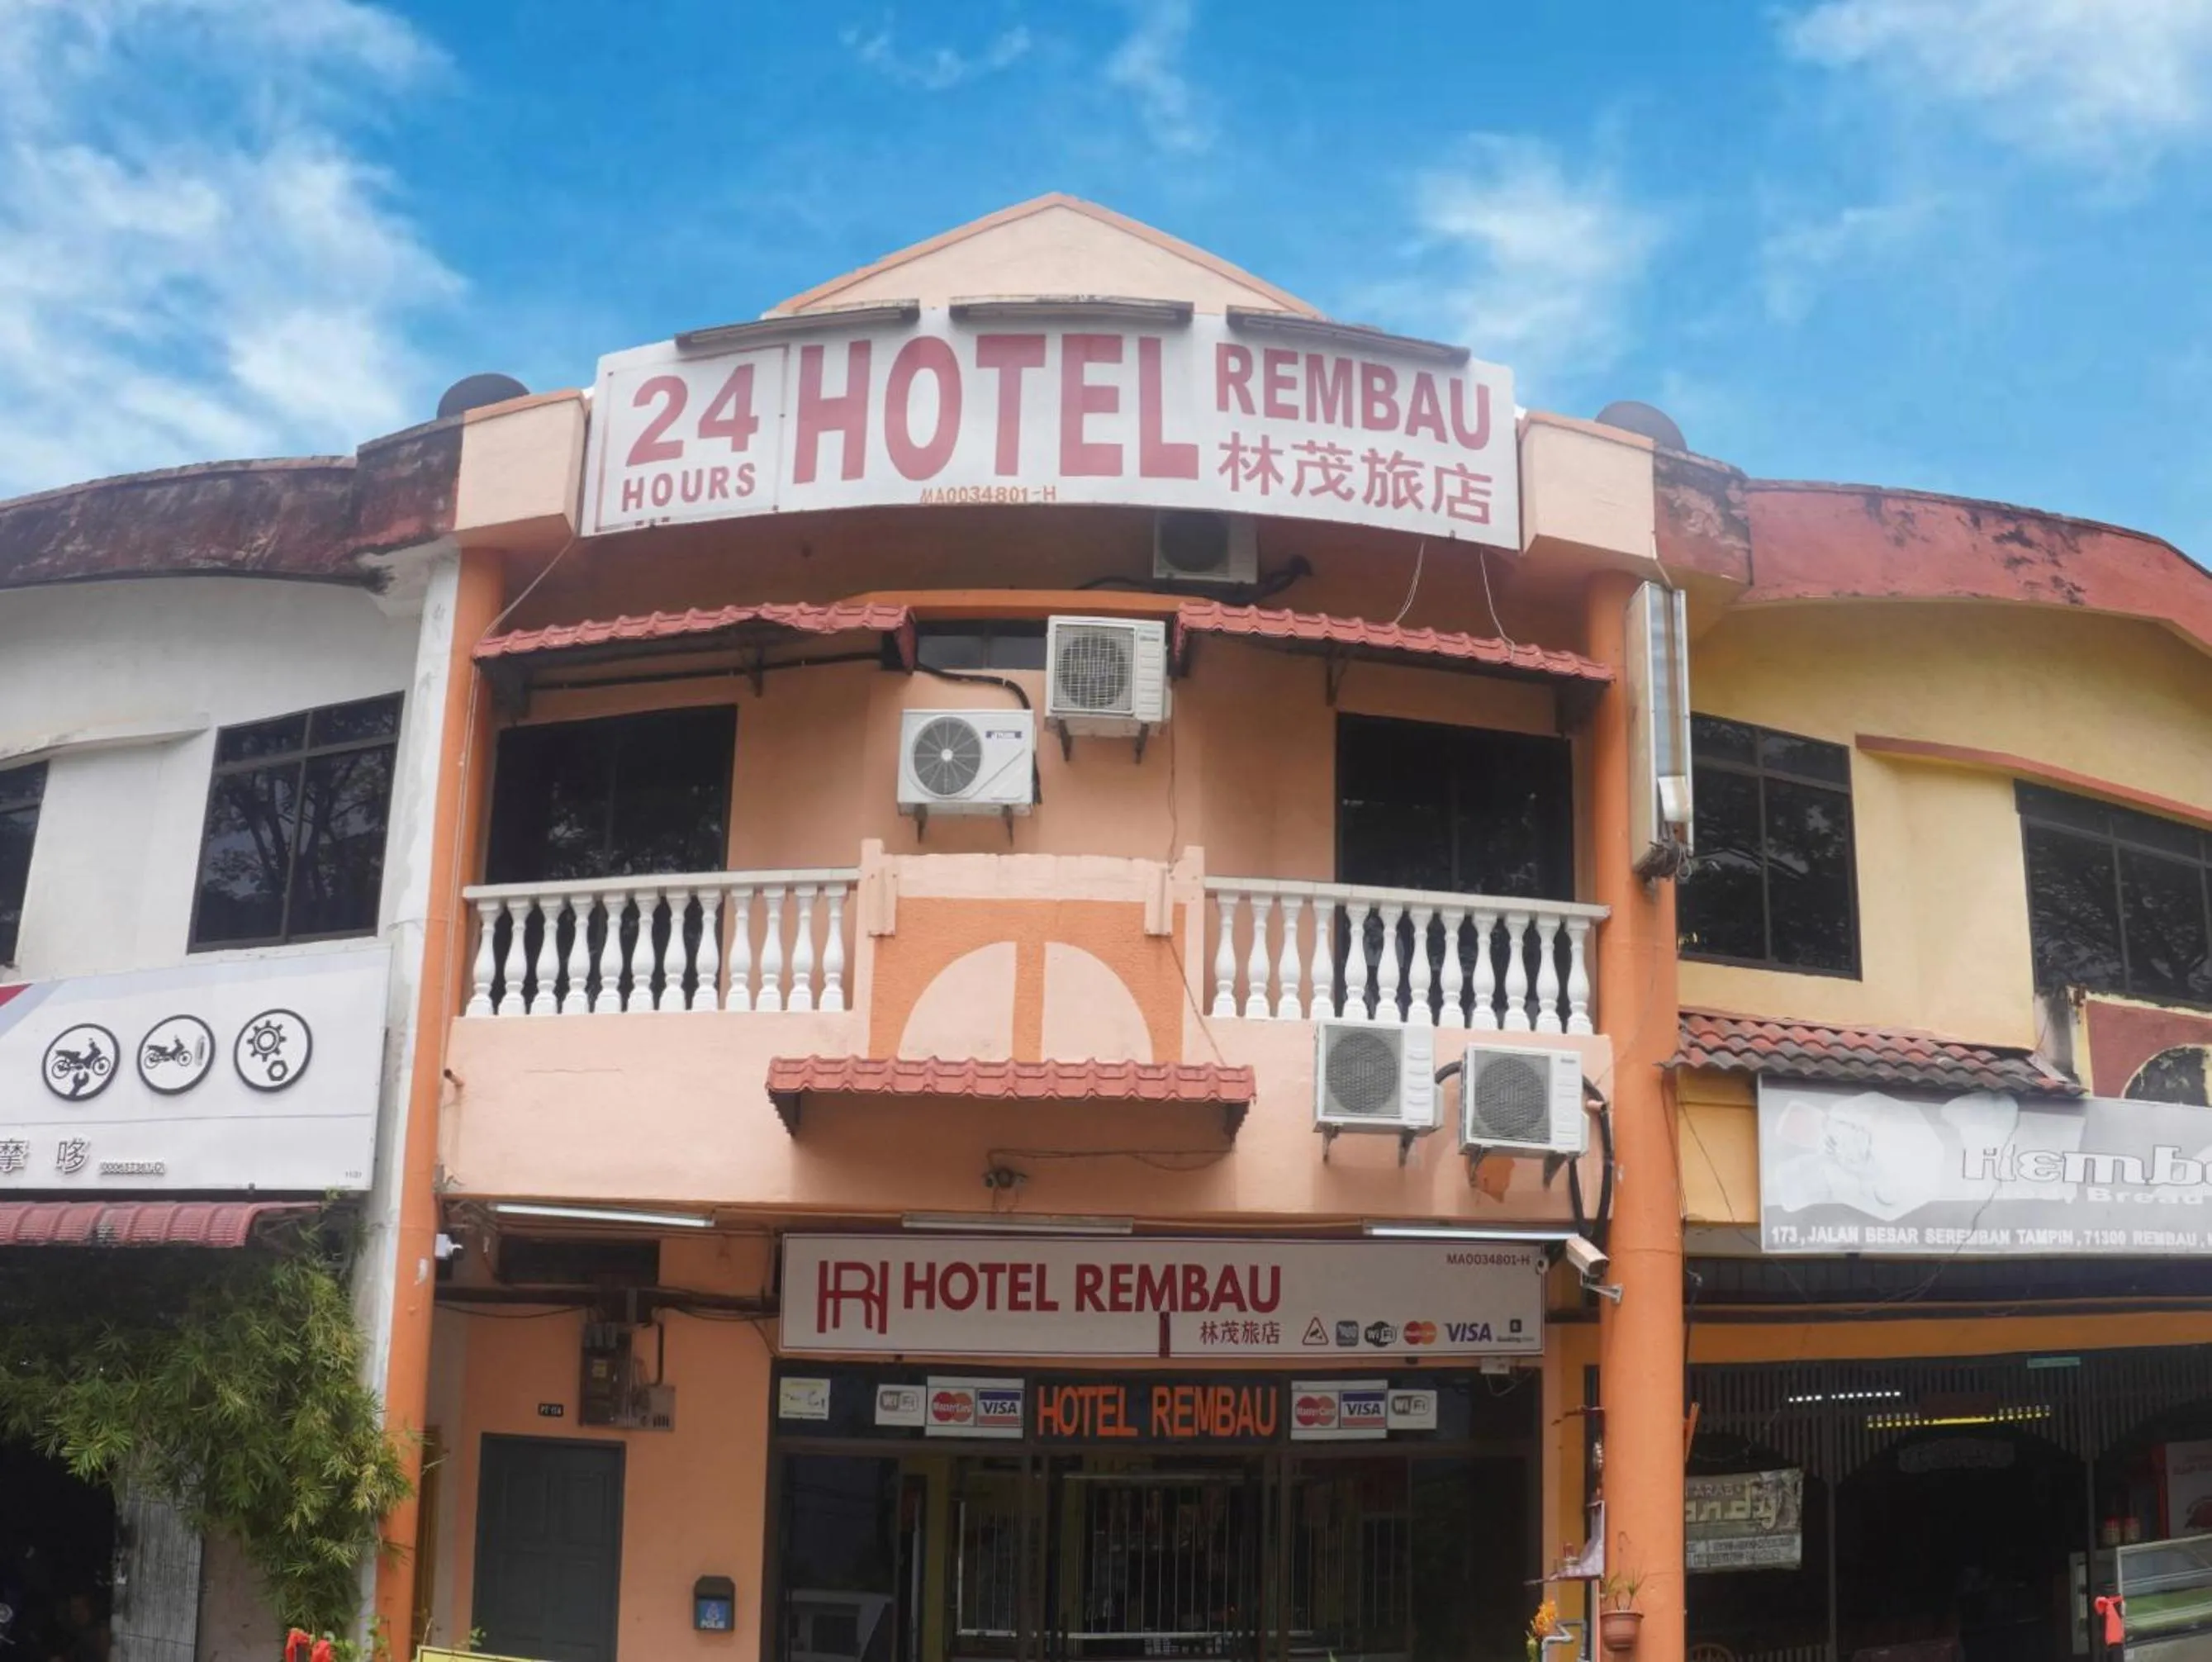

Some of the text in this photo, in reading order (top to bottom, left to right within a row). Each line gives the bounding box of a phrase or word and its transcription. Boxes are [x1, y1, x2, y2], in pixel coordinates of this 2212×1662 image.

[625, 362, 760, 468] 24
[793, 333, 1199, 484] HOTEL
[1216, 341, 1490, 451] REMBAU
[621, 462, 757, 513] HOURS
[919, 485, 1057, 504] MA0034801-H
[1218, 430, 1493, 525] 林茂旅店
[1806, 1226, 1859, 1244] JALAN
[1864, 1227, 1919, 1245] BESAR
[1925, 1228, 2011, 1245] SEREMBAN
[904, 1261, 1281, 1314] HOTEL REMBAU
[1199, 1321, 1281, 1346] 林茂旅店
[1445, 1323, 1492, 1342] VISA
[981, 1402, 1018, 1415] VISA
[1037, 1385, 1277, 1437] HOTEL REMBAU
[1346, 1403, 1381, 1416] VISA
